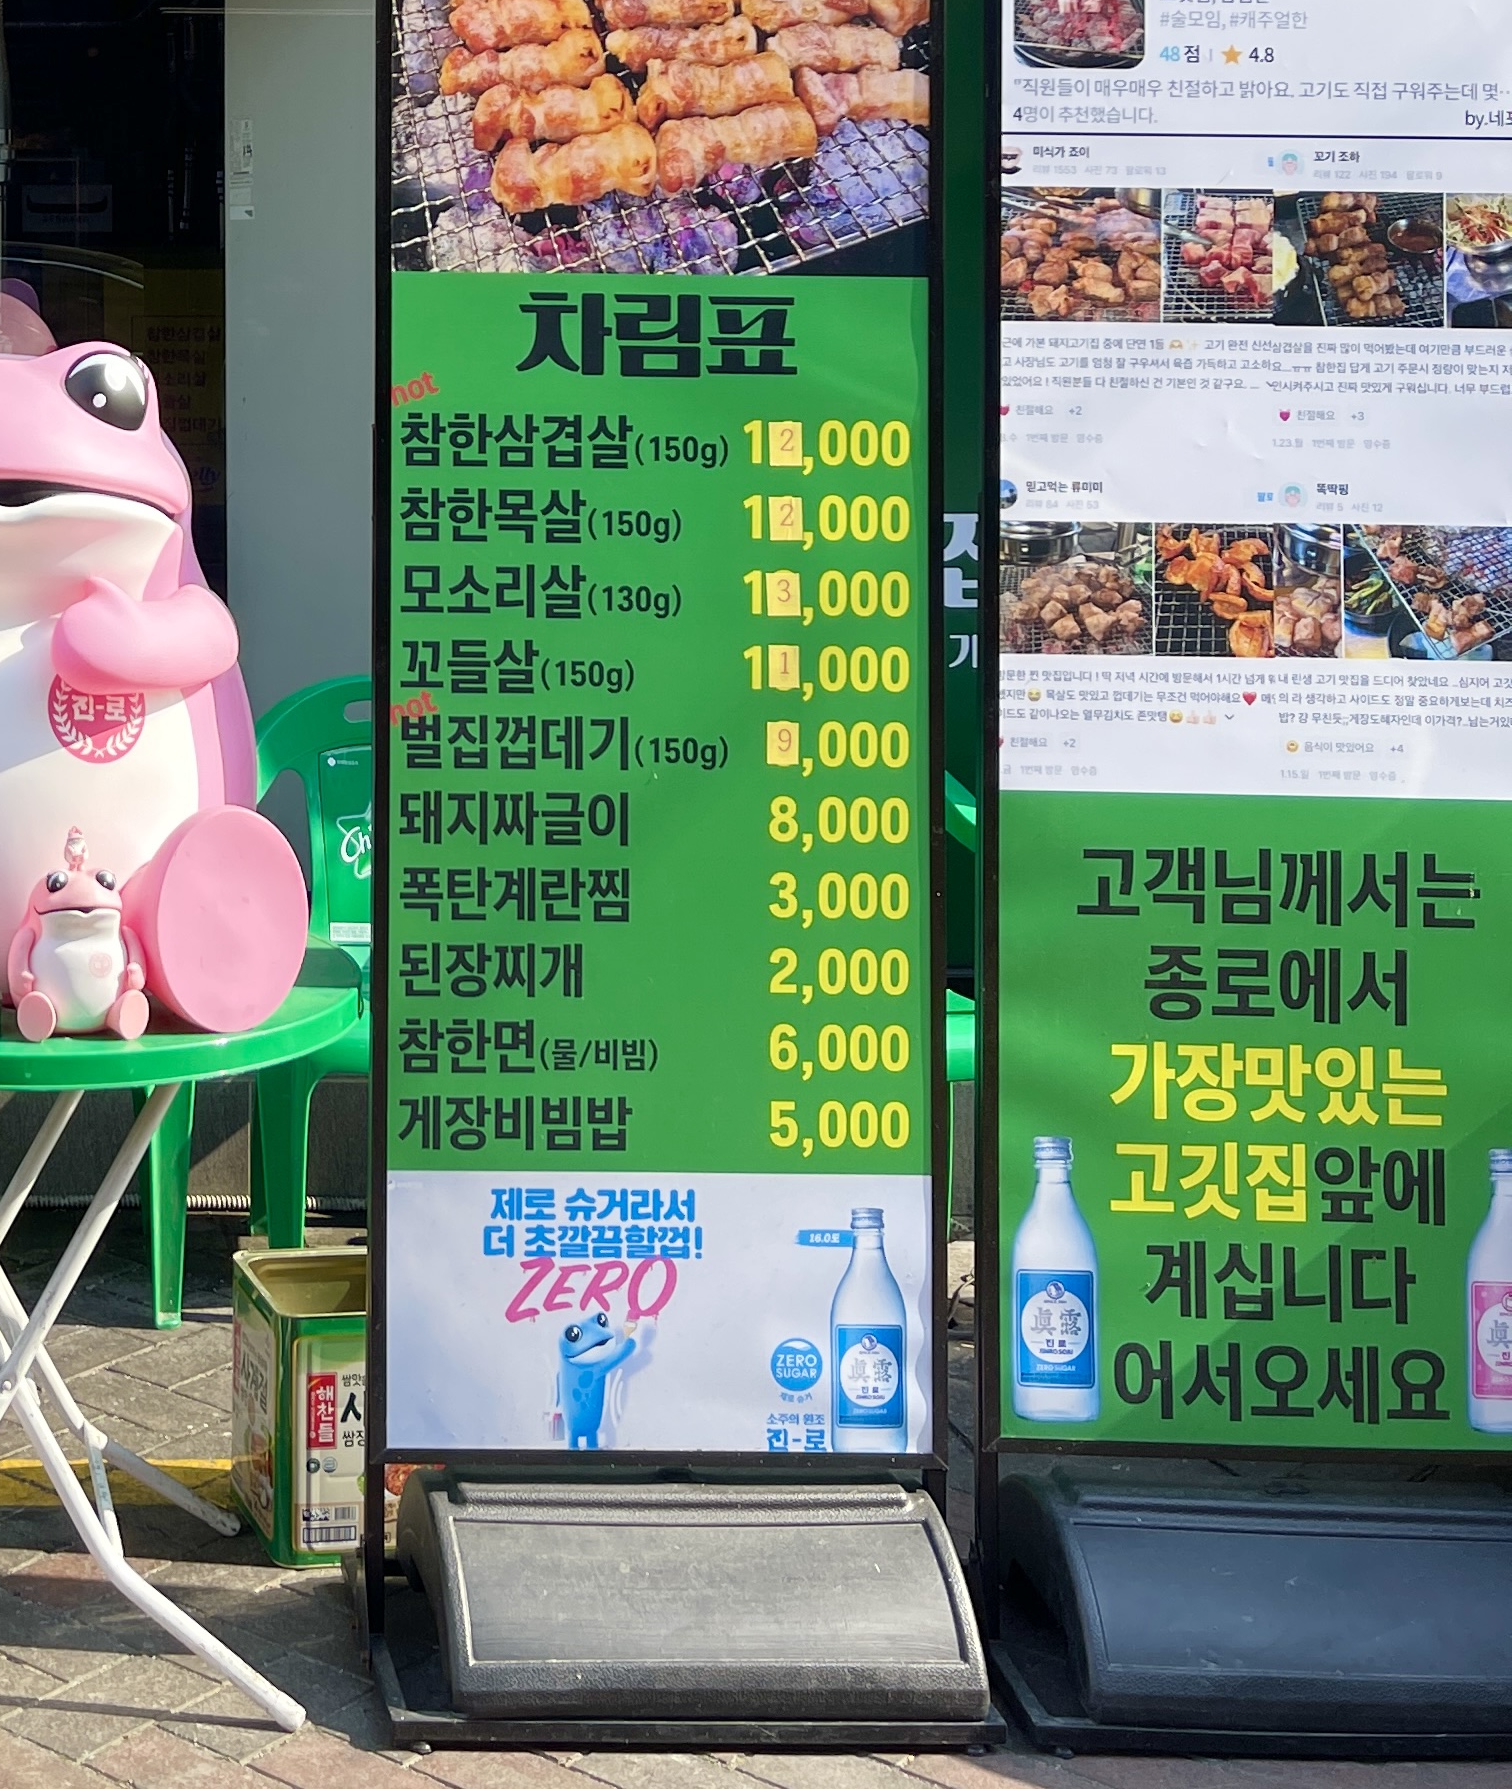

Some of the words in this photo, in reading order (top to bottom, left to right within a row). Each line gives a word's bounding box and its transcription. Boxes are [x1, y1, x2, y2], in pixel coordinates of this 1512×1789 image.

[1229, 10, 1308, 31] #캐주얼한
[1248, 47, 1275, 64] 4.8
[1012, 105, 1055, 124] 4명이
[1058, 105, 1158, 124] 추천했습니다.
[1094, 79, 1164, 98] 매우매우
[1168, 80, 1235, 99] 친절하고
[1239, 80, 1295, 99] 밝아요.
[1298, 81, 1350, 100] 고기도
[1353, 81, 1388, 100] 직접
[1392, 82, 1479, 101] 구워주는데
[516, 292, 798, 377] 차림표
[743, 419, 911, 474] 12,000
[743, 494, 911, 550] 12,000
[743, 569, 911, 625] 13,000
[743, 645, 911, 701] 11,000
[767, 720, 911, 777] 9,000
[399, 791, 631, 847] 돼지짜글이
[767, 795, 911, 852] 8,000
[399, 867, 631, 923] 폭탄계란찜
[767, 871, 911, 929] 3,000
[1077, 847, 1481, 929] 고객님께서는
[399, 942, 584, 998] 된장찌개
[767, 947, 911, 1004] 2,000
[1144, 944, 1409, 1027] 종로에서
[767, 1023, 911, 1080] 6,000
[1109, 1041, 1448, 1127] 가장맛있는
[399, 1095, 633, 1151] 게장비빔밥
[767, 1099, 911, 1156] 5,000
[490, 1188, 556, 1222] 제로
[565, 1188, 696, 1223] 슈거라서
[1109, 1142, 1446, 1227] 고깃집앞에
[483, 1227, 516, 1258] 더
[524, 1226, 703, 1260] 초깔끔할껍!
[505, 1255, 678, 1324] ZERO
[1145, 1241, 1417, 1325] 계십니다
[776, 1354, 818, 1367] ZERO
[776, 1368, 818, 1379] SUGAR
[1113, 1340, 1451, 1425] 어서오세요
[316, 1385, 335, 1443] 해찬들
[766, 1413, 800, 1425] 소주의
[803, 1413, 826, 1425] 원조
[766, 1428, 827, 1452] 진-로
